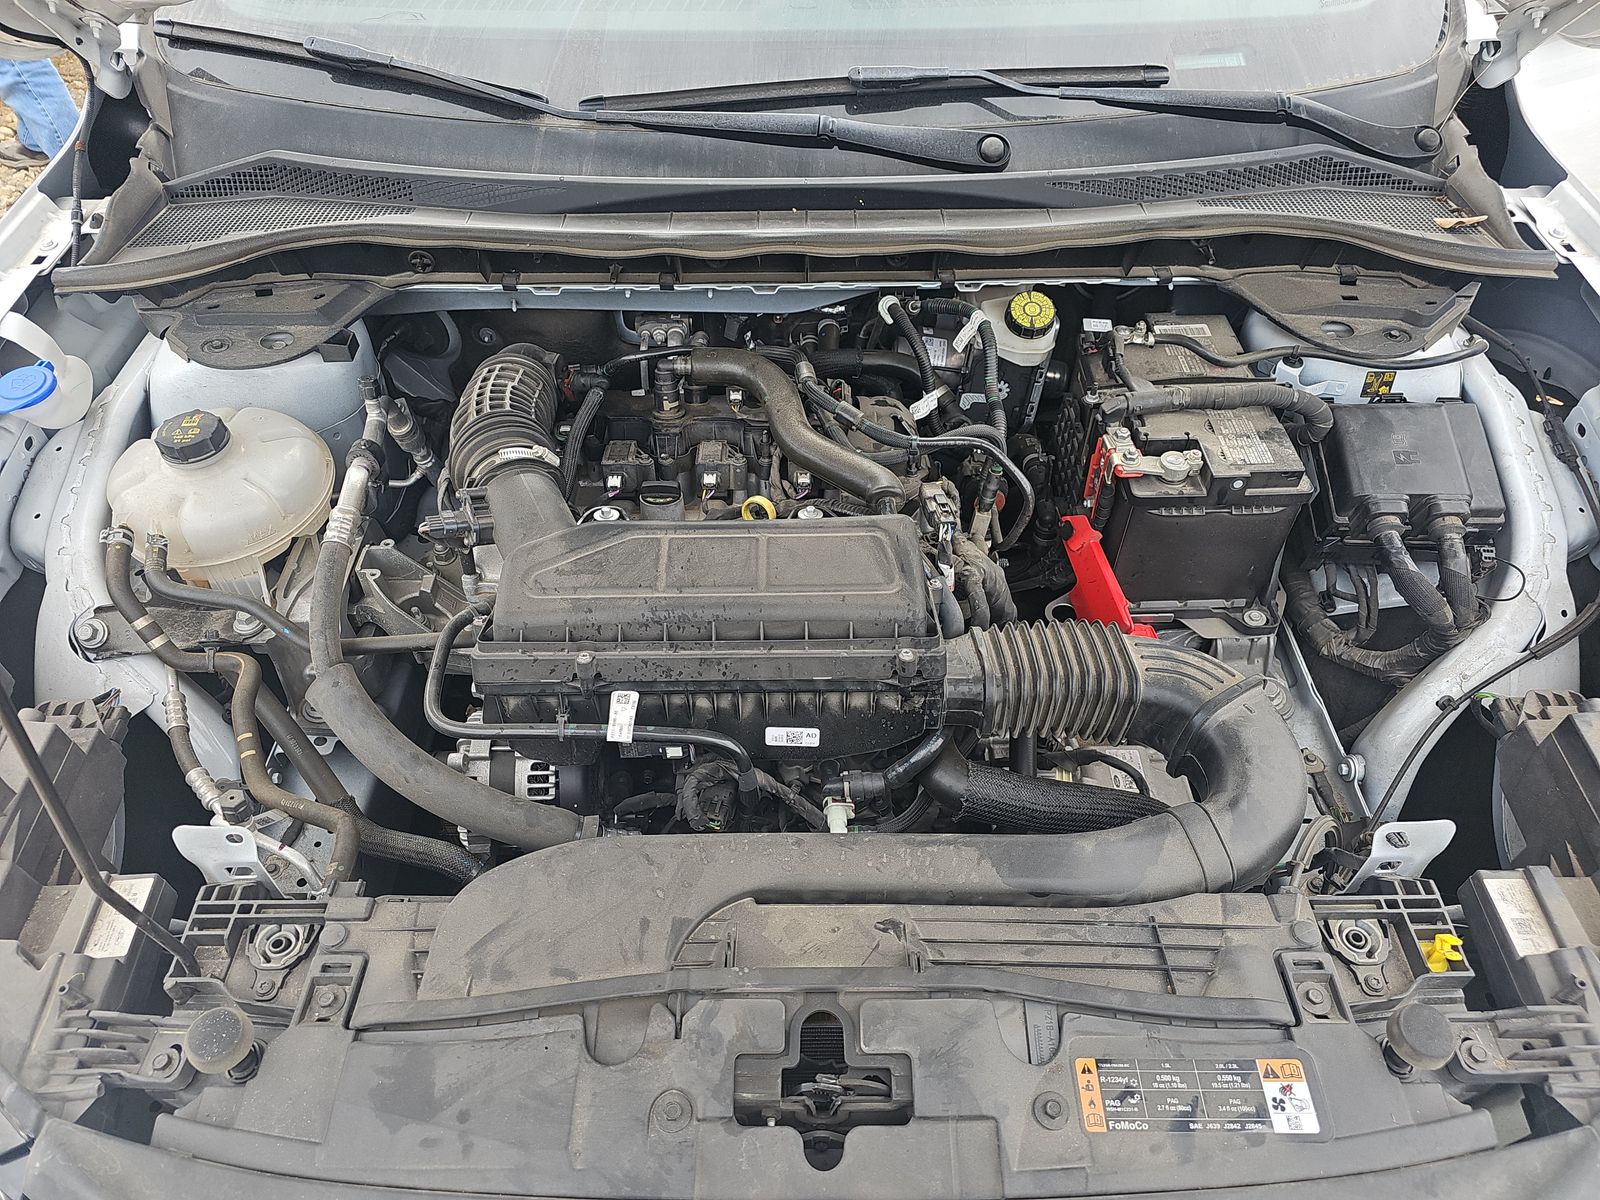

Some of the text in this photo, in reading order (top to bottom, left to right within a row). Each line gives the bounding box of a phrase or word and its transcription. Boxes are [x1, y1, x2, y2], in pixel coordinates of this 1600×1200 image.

[1100, 1075, 1128, 1084] R-1234yf
[1156, 1074, 1180, 1083] 0.500 kg
[1217, 1074, 1241, 1082] 0.550 kg
[1105, 1099, 1121, 1107] PAG
[1108, 1120, 1149, 1130] FoMoCo
